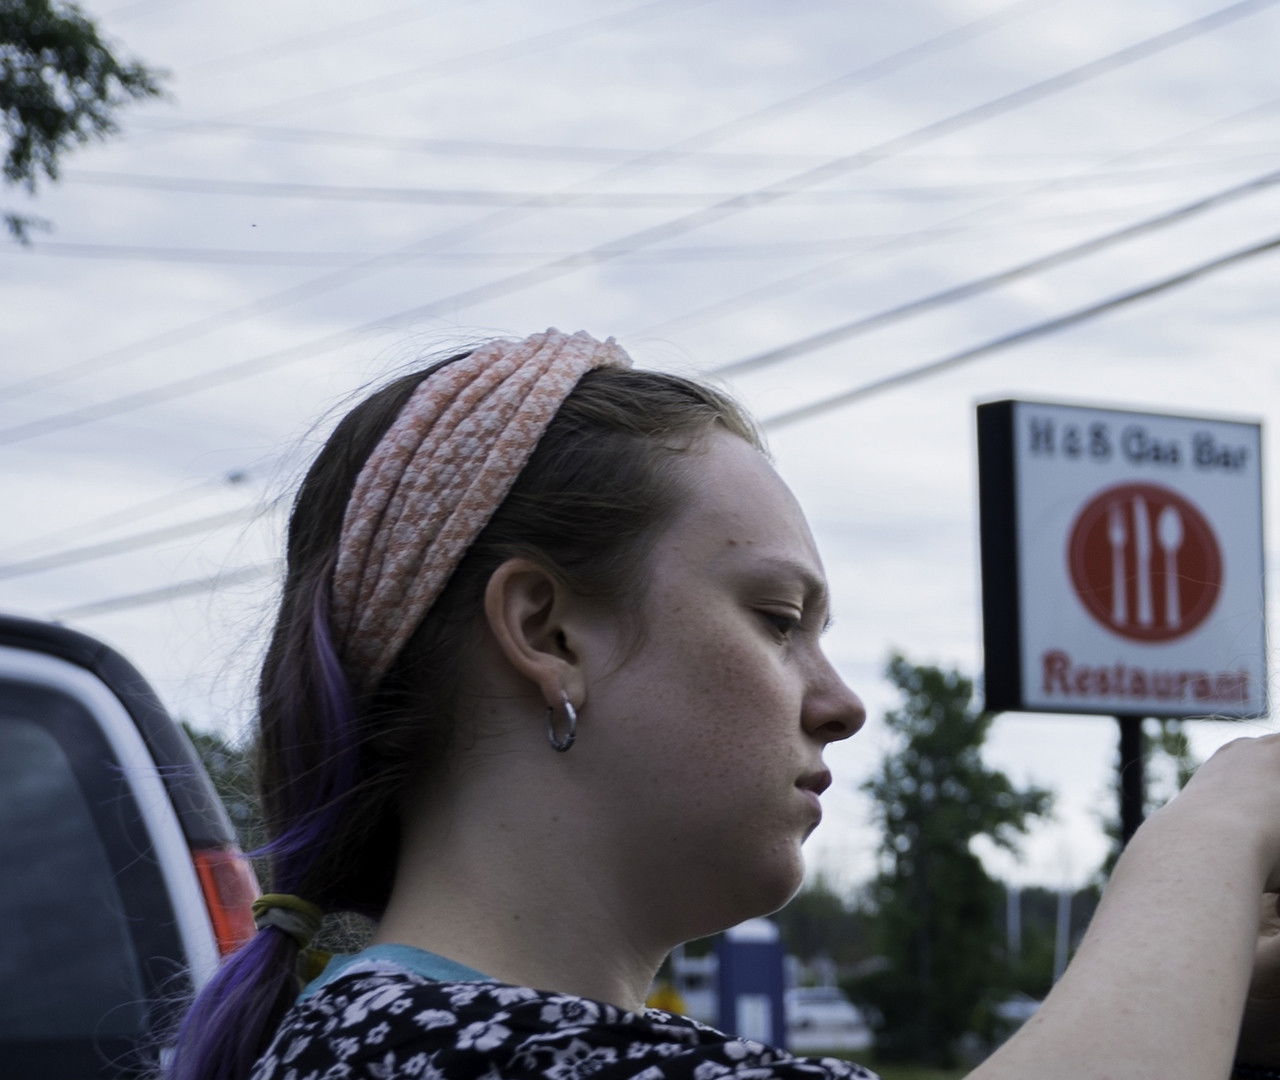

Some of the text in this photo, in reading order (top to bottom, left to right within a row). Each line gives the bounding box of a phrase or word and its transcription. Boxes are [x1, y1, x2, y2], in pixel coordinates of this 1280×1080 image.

[1121, 425, 1180, 467] Gas
[1192, 431, 1247, 471] Bar
[1042, 650, 1250, 702] Restaurant
